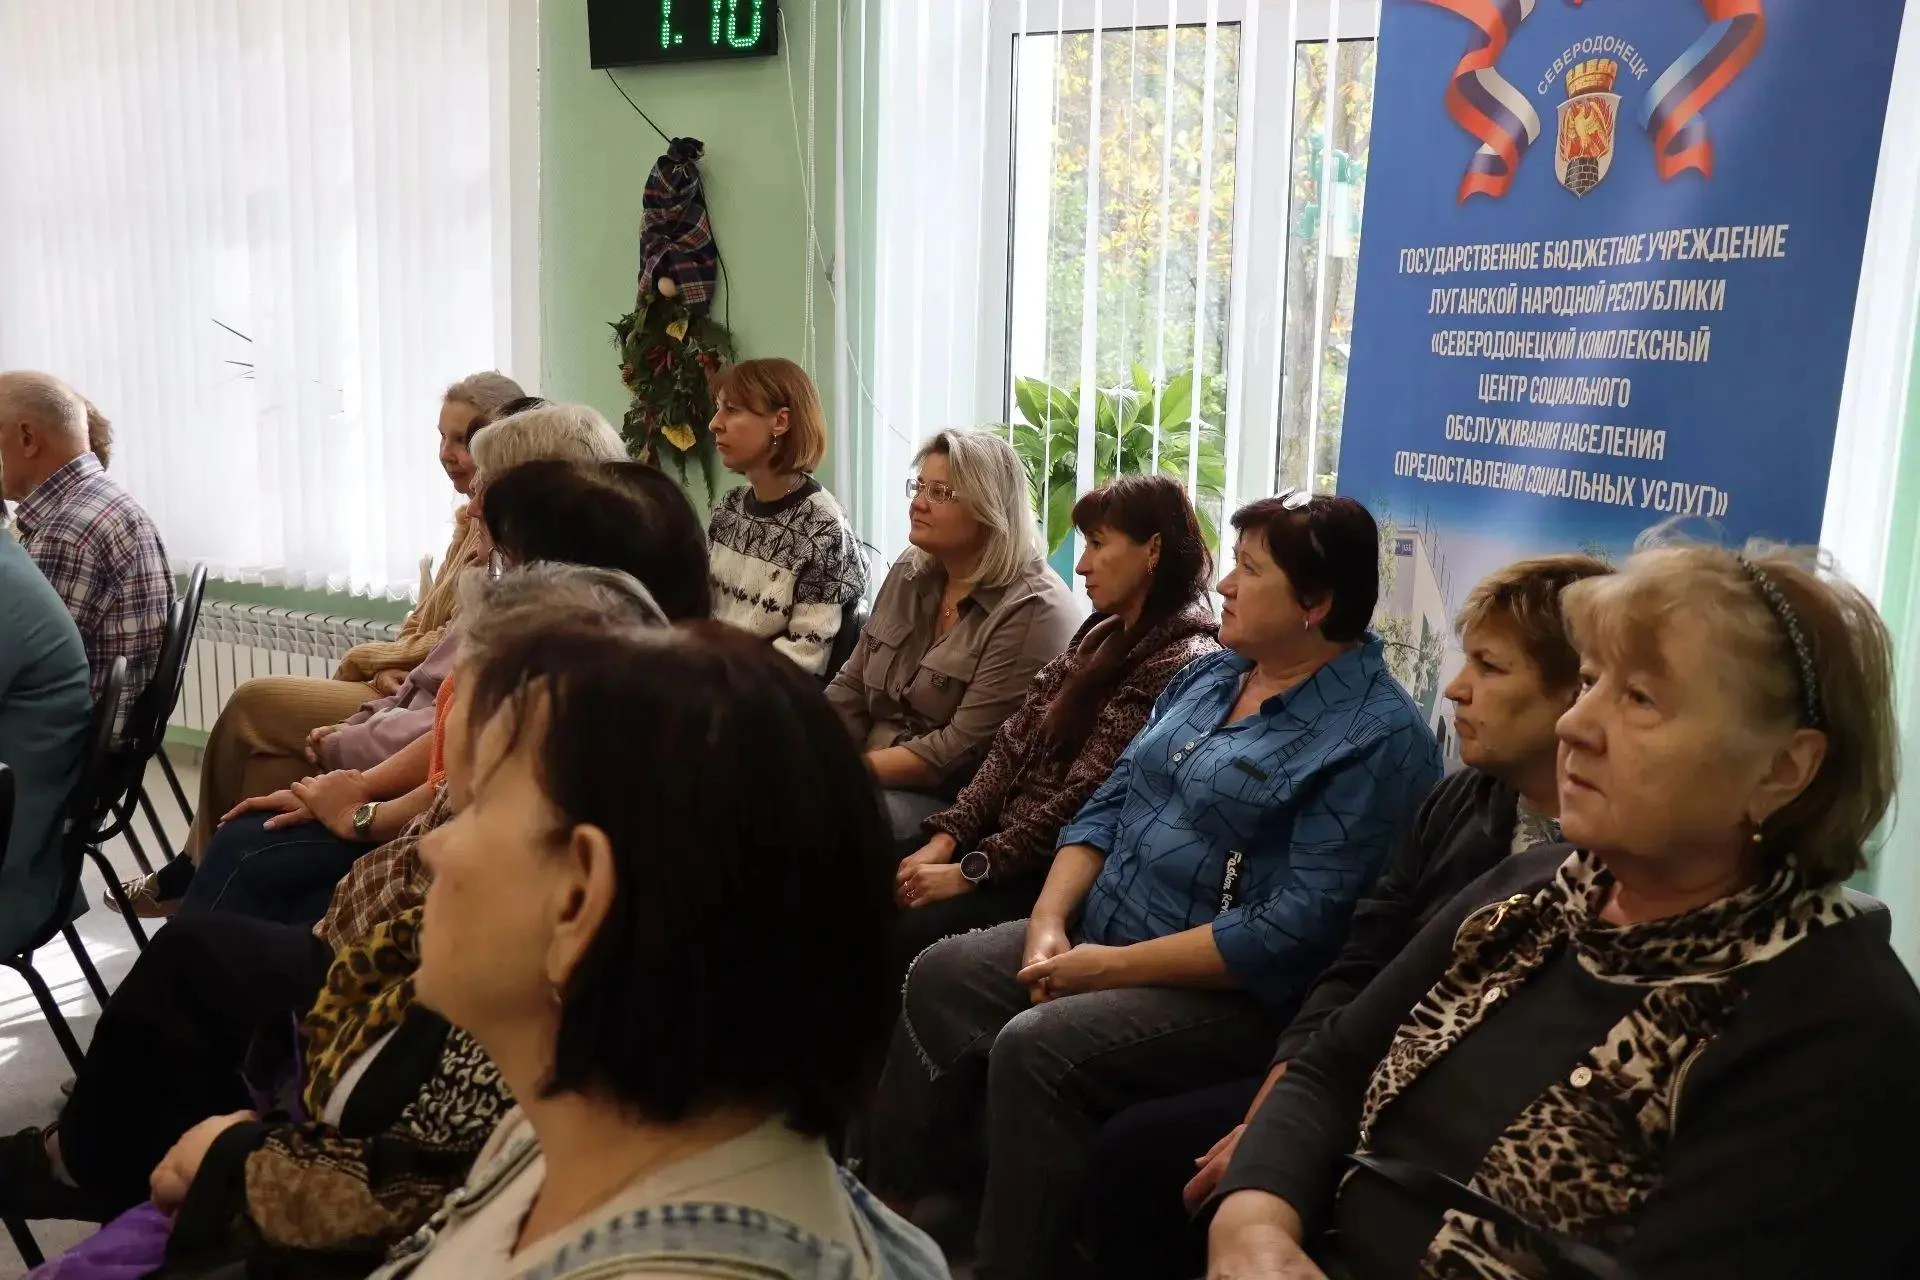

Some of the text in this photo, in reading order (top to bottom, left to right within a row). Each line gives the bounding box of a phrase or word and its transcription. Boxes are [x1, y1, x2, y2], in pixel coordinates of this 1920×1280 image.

[1537, 35, 1648, 95] СЕВЕРОДОНЕЦК
[1399, 224, 1789, 275] ГОСУДАРСТВЕННОЕ БЮДЖЕТНОЕ УЧРЕЖДЕНИЕ
[1428, 279, 1726, 316] ЛУГАНСКОЙ НАРОДНОЙ РЕСПУБЛИКИ
[1431, 326, 1711, 363] «СЕВЕРОДОНЕЦКИЙ КОМПЛЕКСНЫЙ
[1478, 374, 1631, 408] ЦЕНТР СОЦИАЛЬНОГО
[1445, 415, 1666, 461] ОБСЛУЖИВАНИЯ НАСЕЛЕНИЯ
[1394, 450, 1729, 517] (ПРЕДОСТАВЛЕНИЯ СОЦИАЛЬНЫХ УСЛУГ)»
[1223, 850, 1242, 890] Fashion
